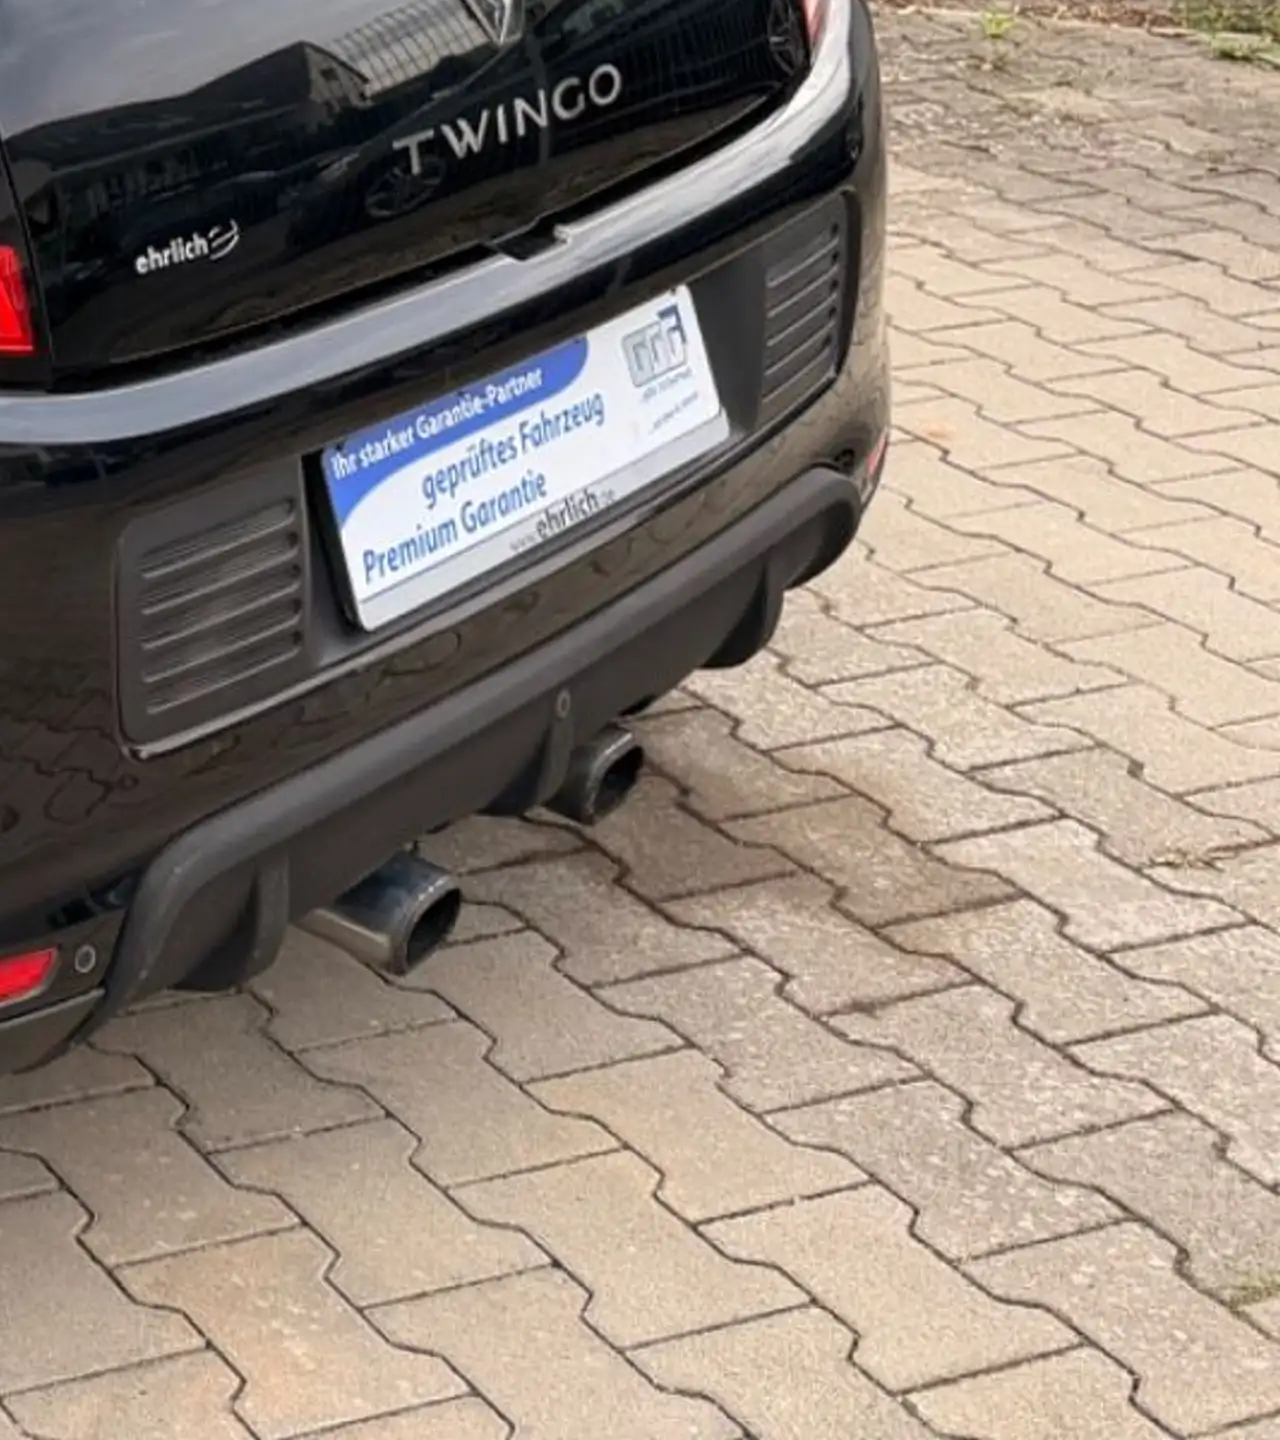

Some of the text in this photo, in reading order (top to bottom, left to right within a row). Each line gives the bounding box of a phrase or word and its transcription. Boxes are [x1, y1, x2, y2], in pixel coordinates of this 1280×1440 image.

[392, 63, 621, 176] TWINGO
[135, 231, 209, 275] ehrlich
[329, 368, 543, 480] Ihr starker Garantie-Partner
[422, 430, 518, 508] geprüftes
[519, 393, 605, 453] Fahrzeug
[363, 469, 547, 585] Premium Garantie
